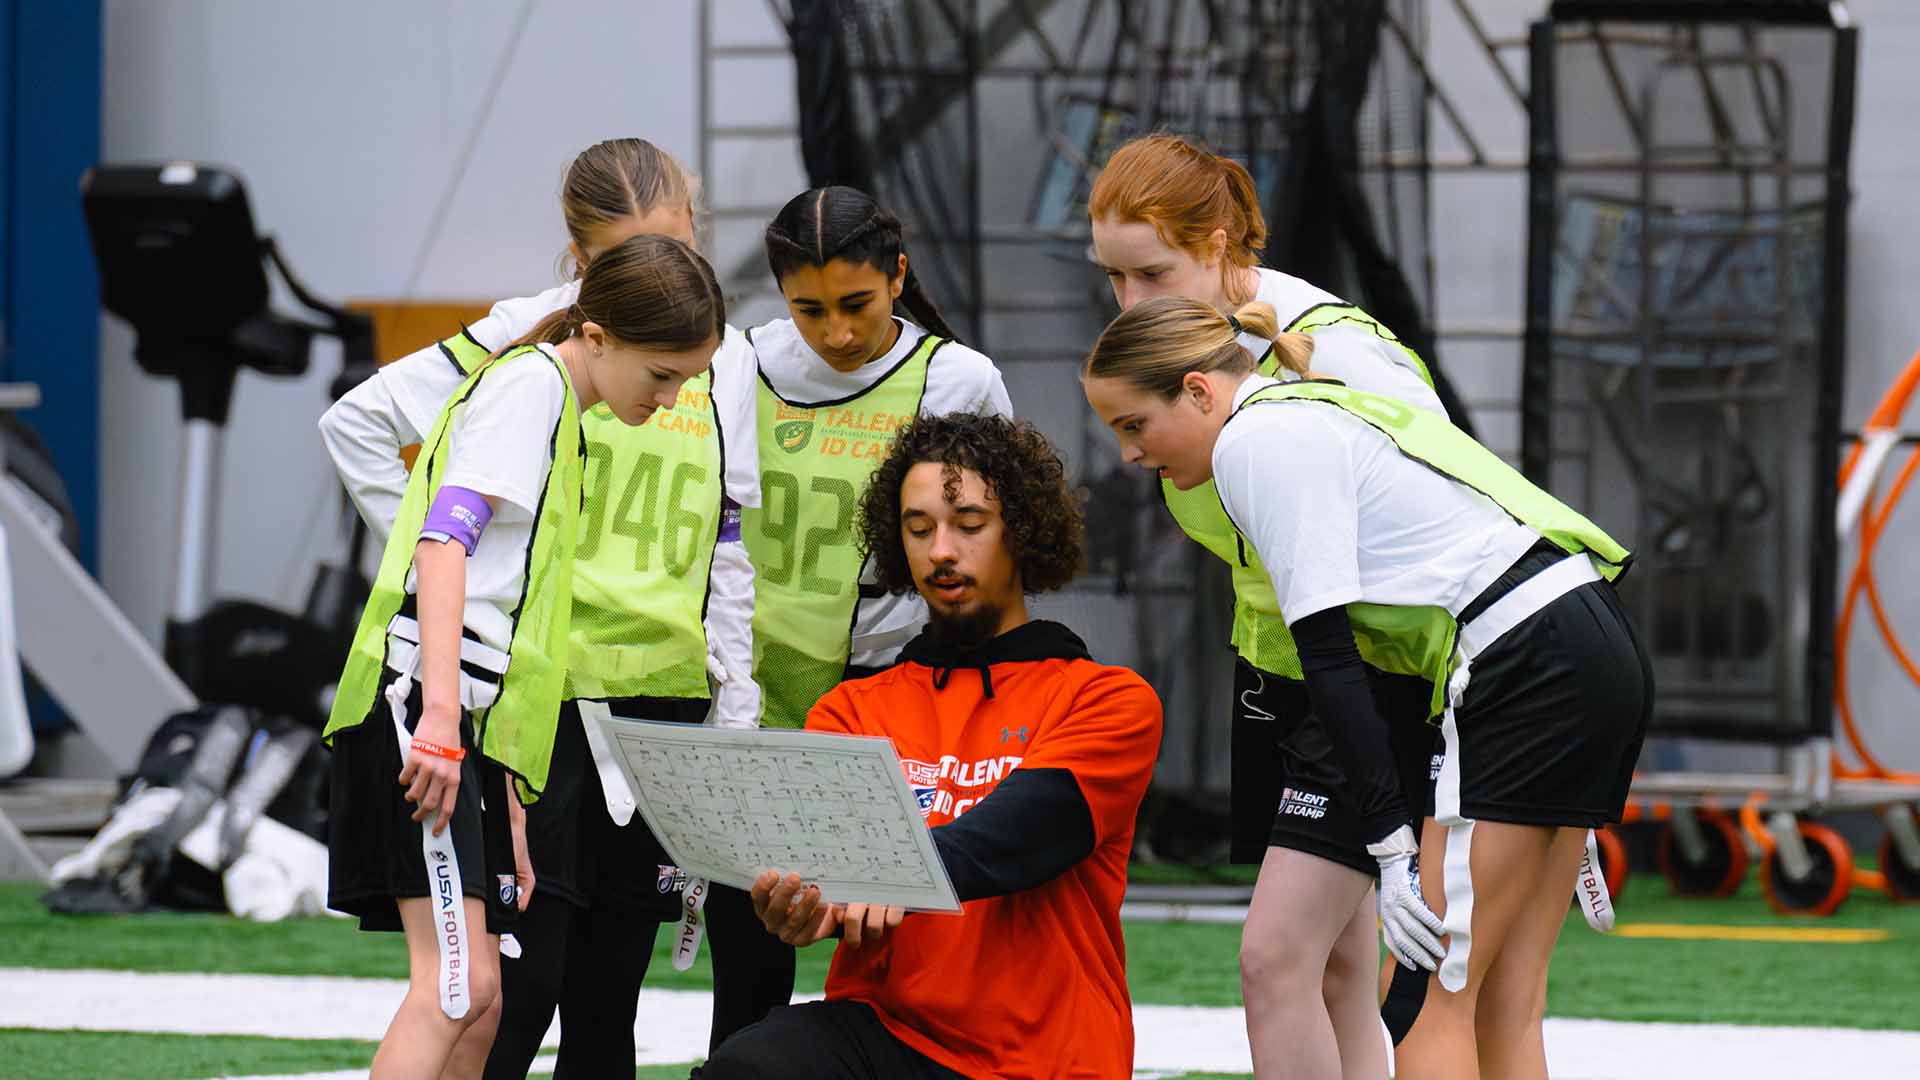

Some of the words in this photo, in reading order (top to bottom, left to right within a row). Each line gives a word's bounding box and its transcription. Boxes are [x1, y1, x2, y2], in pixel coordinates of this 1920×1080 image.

[657, 411, 712, 440] CAMP
[819, 436, 848, 456] ID
[939, 755, 1023, 786] TALENT
[932, 789, 953, 816] ID
[1293, 805, 1325, 819] CAMP
[436, 864, 453, 909] USA
[442, 910, 461, 1003] FOOTBALL
